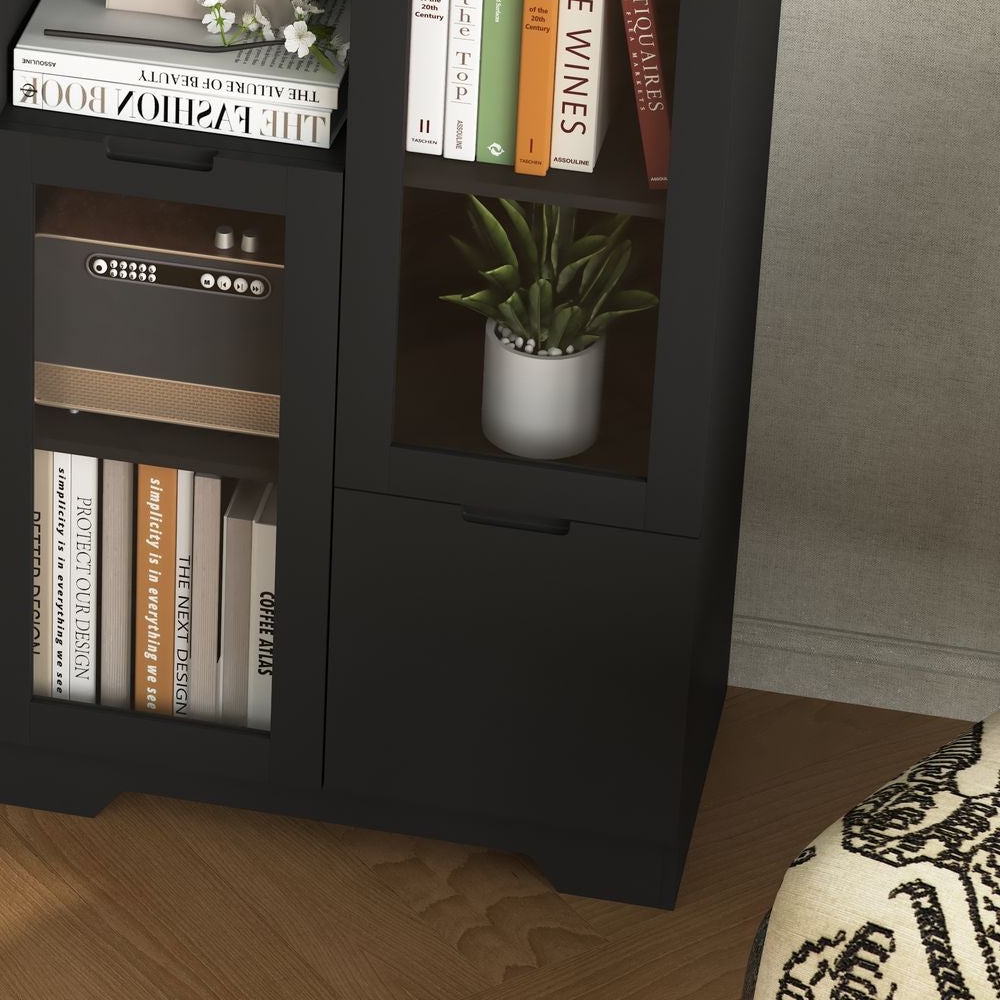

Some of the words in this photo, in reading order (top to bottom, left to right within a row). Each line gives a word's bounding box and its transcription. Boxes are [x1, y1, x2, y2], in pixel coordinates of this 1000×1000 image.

[415, 11, 444, 21] Century
[421, 4, 439, 12] 20th
[538, 7, 549, 15] the
[525, 24, 551, 34] Century
[531, 15, 546, 23] 20th
[21, 58, 57, 68] ASSOULINE
[625, 11, 635, 42] FLEA
[632, 52, 646, 111] MARKETS
[138, 69, 198, 89] BEAUTY
[202, 77, 222, 92] OF
[561, 29, 592, 135] WINES
[226, 80, 285, 99] ALLURE
[288, 87, 320, 104] THE
[411, 137, 438, 145] TASCHEN
[455, 120, 464, 149] ASSOULINE
[519, 158, 542, 166] TASCHEN
[553, 157, 590, 166] ASSOULINE
[56, 467, 65, 534] simplicity
[146, 478, 164, 548] simplicity
[75, 495, 93, 576] PROTECT
[57, 542, 65, 552] is
[57, 557, 64, 569] in
[148, 551, 163, 566] is
[148, 568, 162, 583] in
[178, 555, 191, 589] THE
[75, 577, 92, 615] OUR
[55, 576, 65, 646] everything
[177, 595, 190, 645] NEXT
[259, 591, 275, 635] COFFEE
[144, 587, 161, 661] everything
[74, 617, 91, 681] DESIGN
[258, 638, 274, 676] ATLAS
[56, 650, 63, 669] we
[146, 663, 158, 683] we
[175, 648, 188, 716] DESIGN
[146, 687, 158, 710] see
